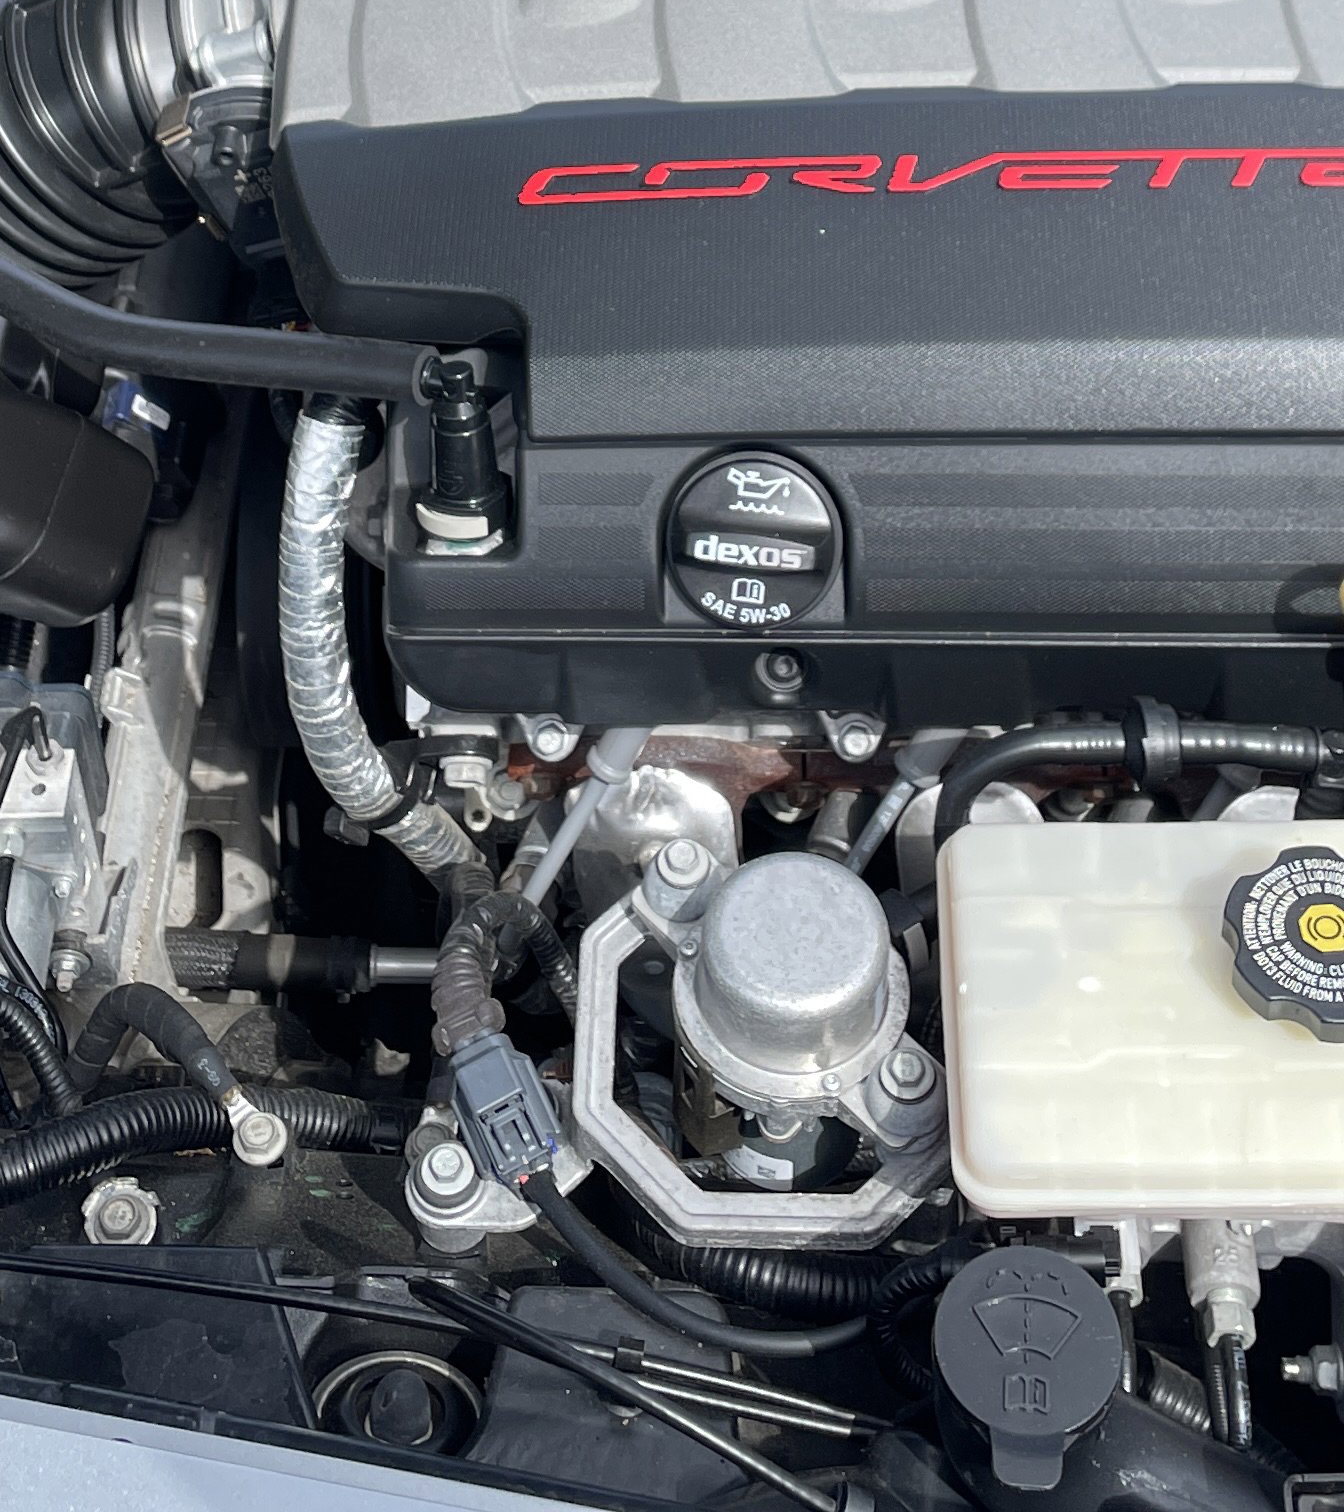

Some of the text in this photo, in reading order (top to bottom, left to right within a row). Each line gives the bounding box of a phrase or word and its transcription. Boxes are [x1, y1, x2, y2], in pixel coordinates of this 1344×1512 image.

[693, 534, 803, 569] dexos
[700, 591, 792, 624] SAE 5W-30
[1287, 859, 1305, 873] LE
[1290, 871, 1308, 886] DU
[1252, 951, 1279, 976] DOT3
[1271, 970, 1303, 994] FLUID
[1301, 984, 1335, 1003] FROM
[1334, 990, 1344, 1003] A
[1265, 945, 1286, 962] CAP
[1278, 959, 1319, 987] BEFORE
